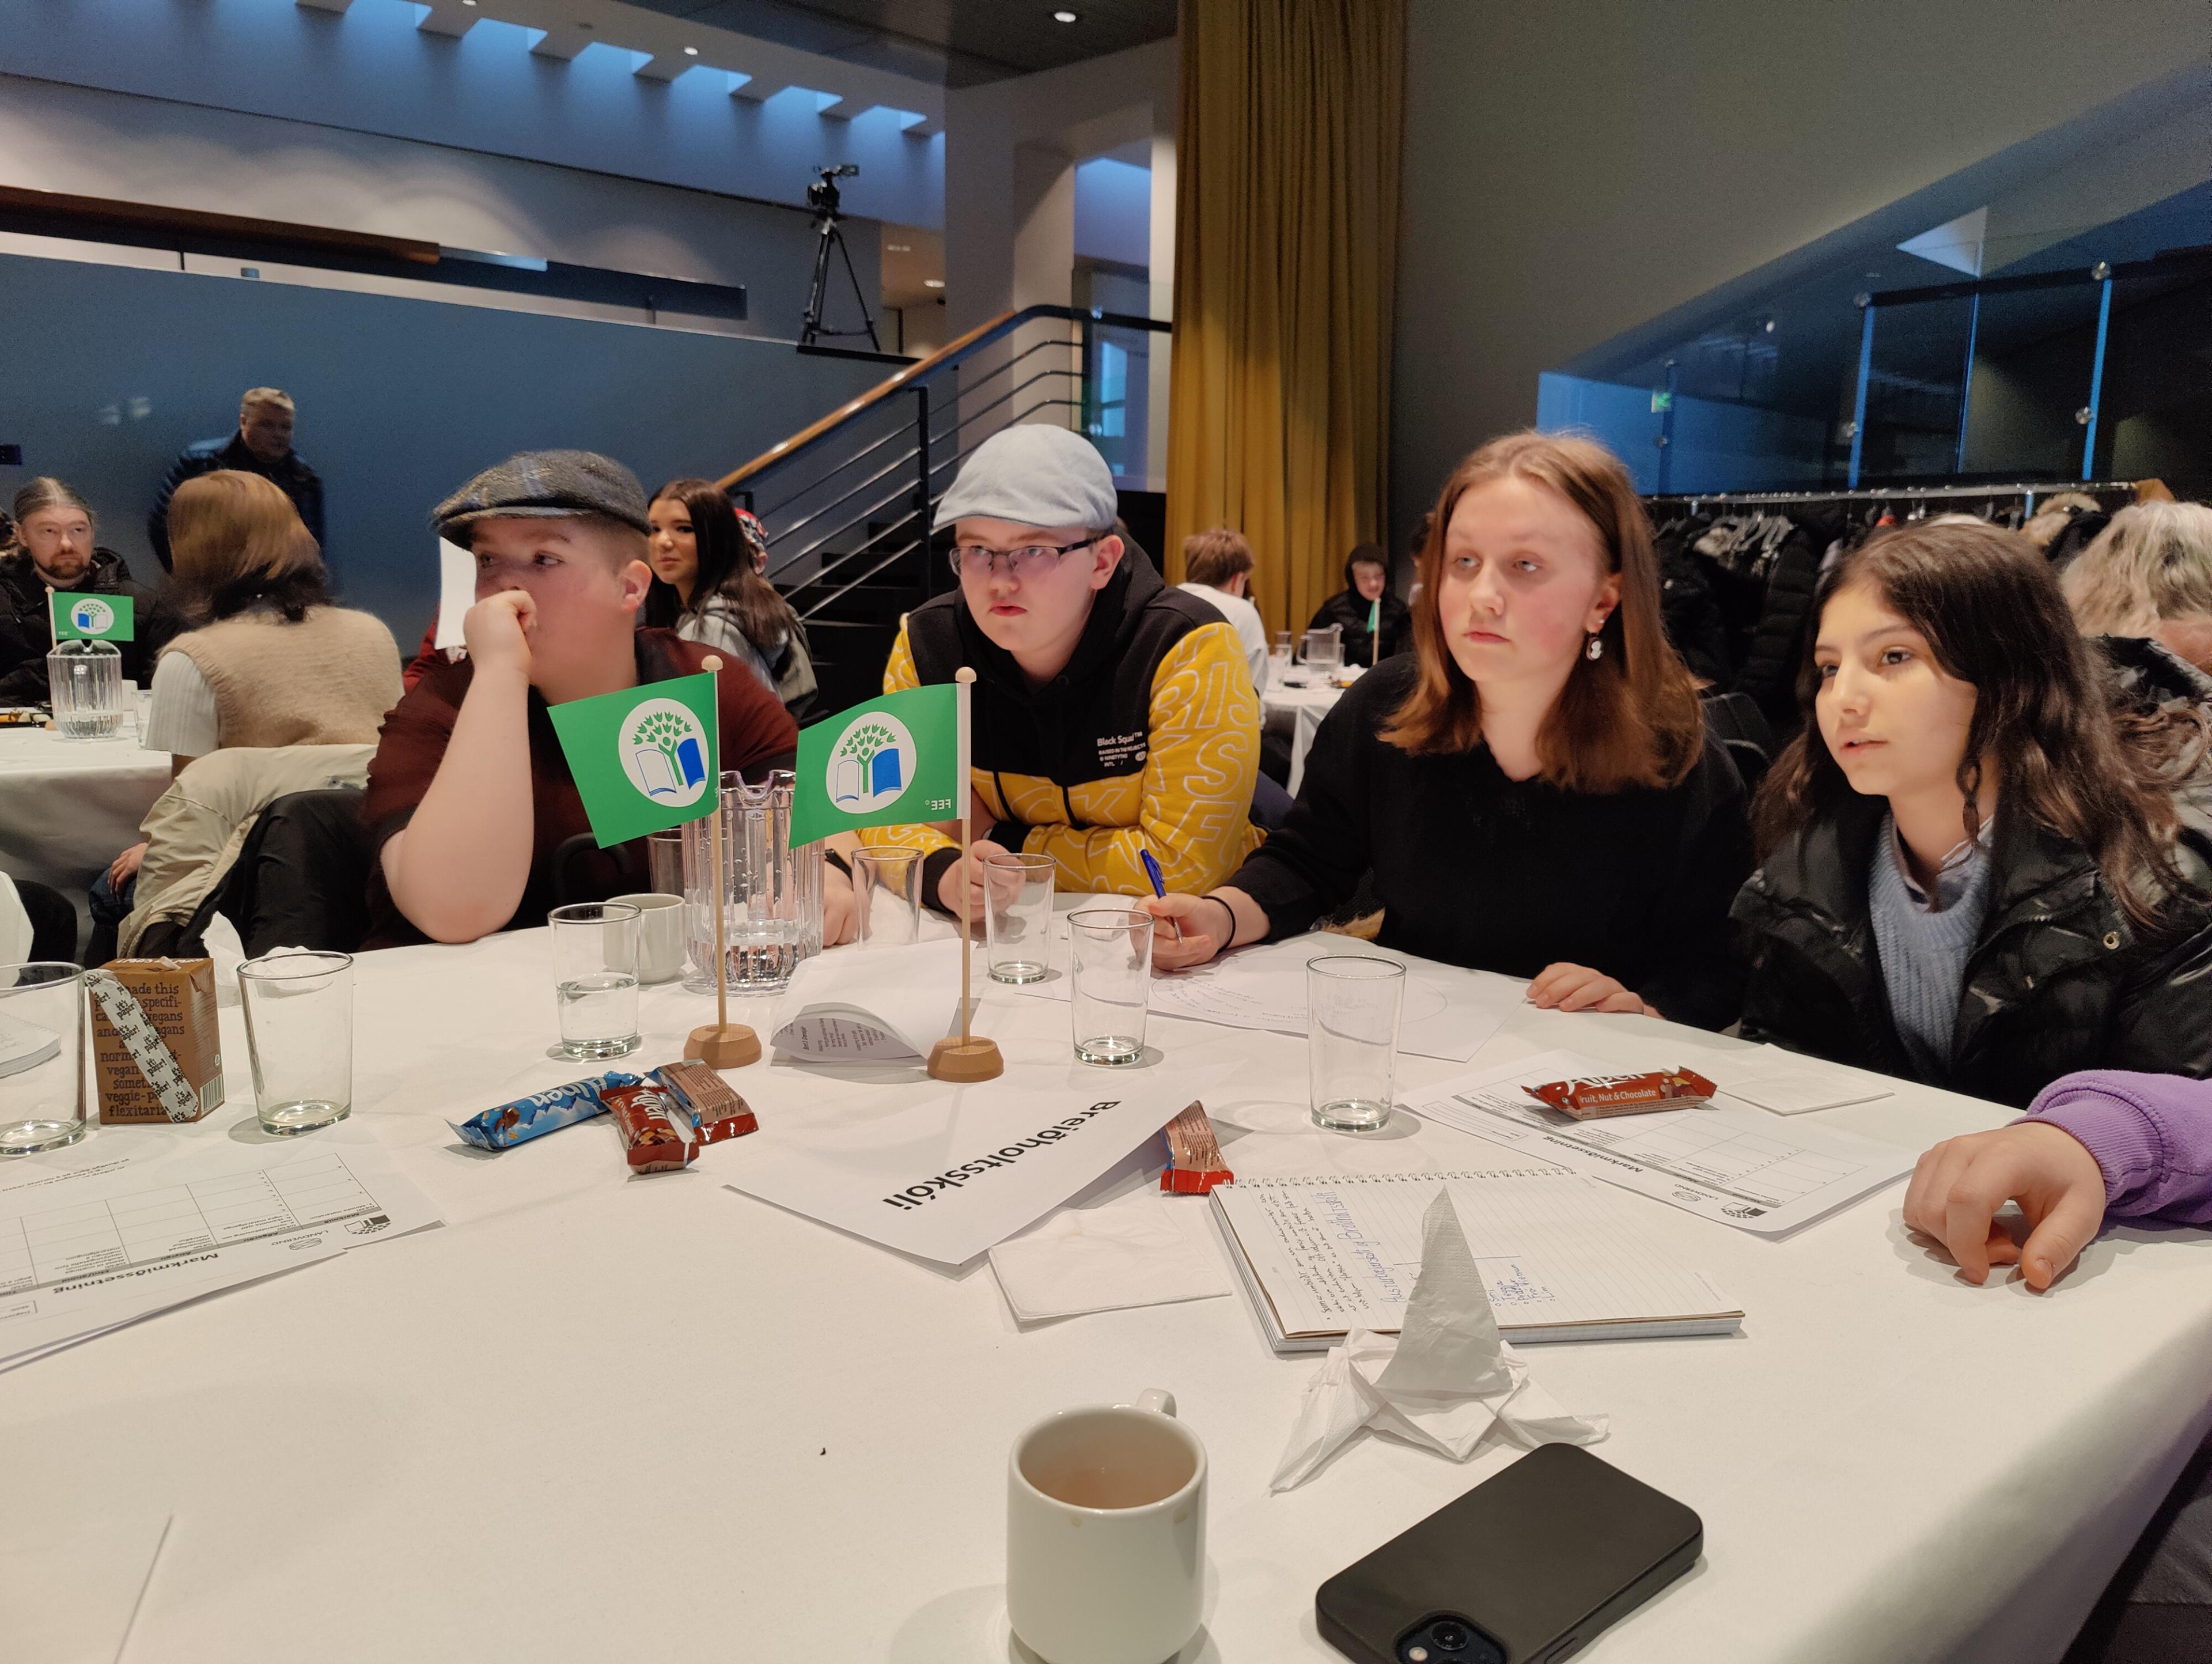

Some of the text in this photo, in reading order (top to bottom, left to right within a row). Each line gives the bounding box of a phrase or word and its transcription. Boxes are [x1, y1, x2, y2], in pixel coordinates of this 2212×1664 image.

[1097, 736, 1116, 747] Black
[154, 982, 179, 994] this
[142, 995, 182, 1011] specifi-
[527, 1076, 608, 1107] Alpen
[1599, 1092, 1612, 1102] Nut
[1614, 1091, 1620, 1099] &
[1620, 1088, 1657, 1099] Chocolate
[882, 1100, 1122, 1211] Breiðholtsskóli
[1540, 1136, 1645, 1172] Markmiðssetning
[1673, 1183, 1720, 1200] LANDVERND
[271, 1230, 329, 1246] LANDVERND
[52, 1251, 219, 1296] Markmiðssetning
